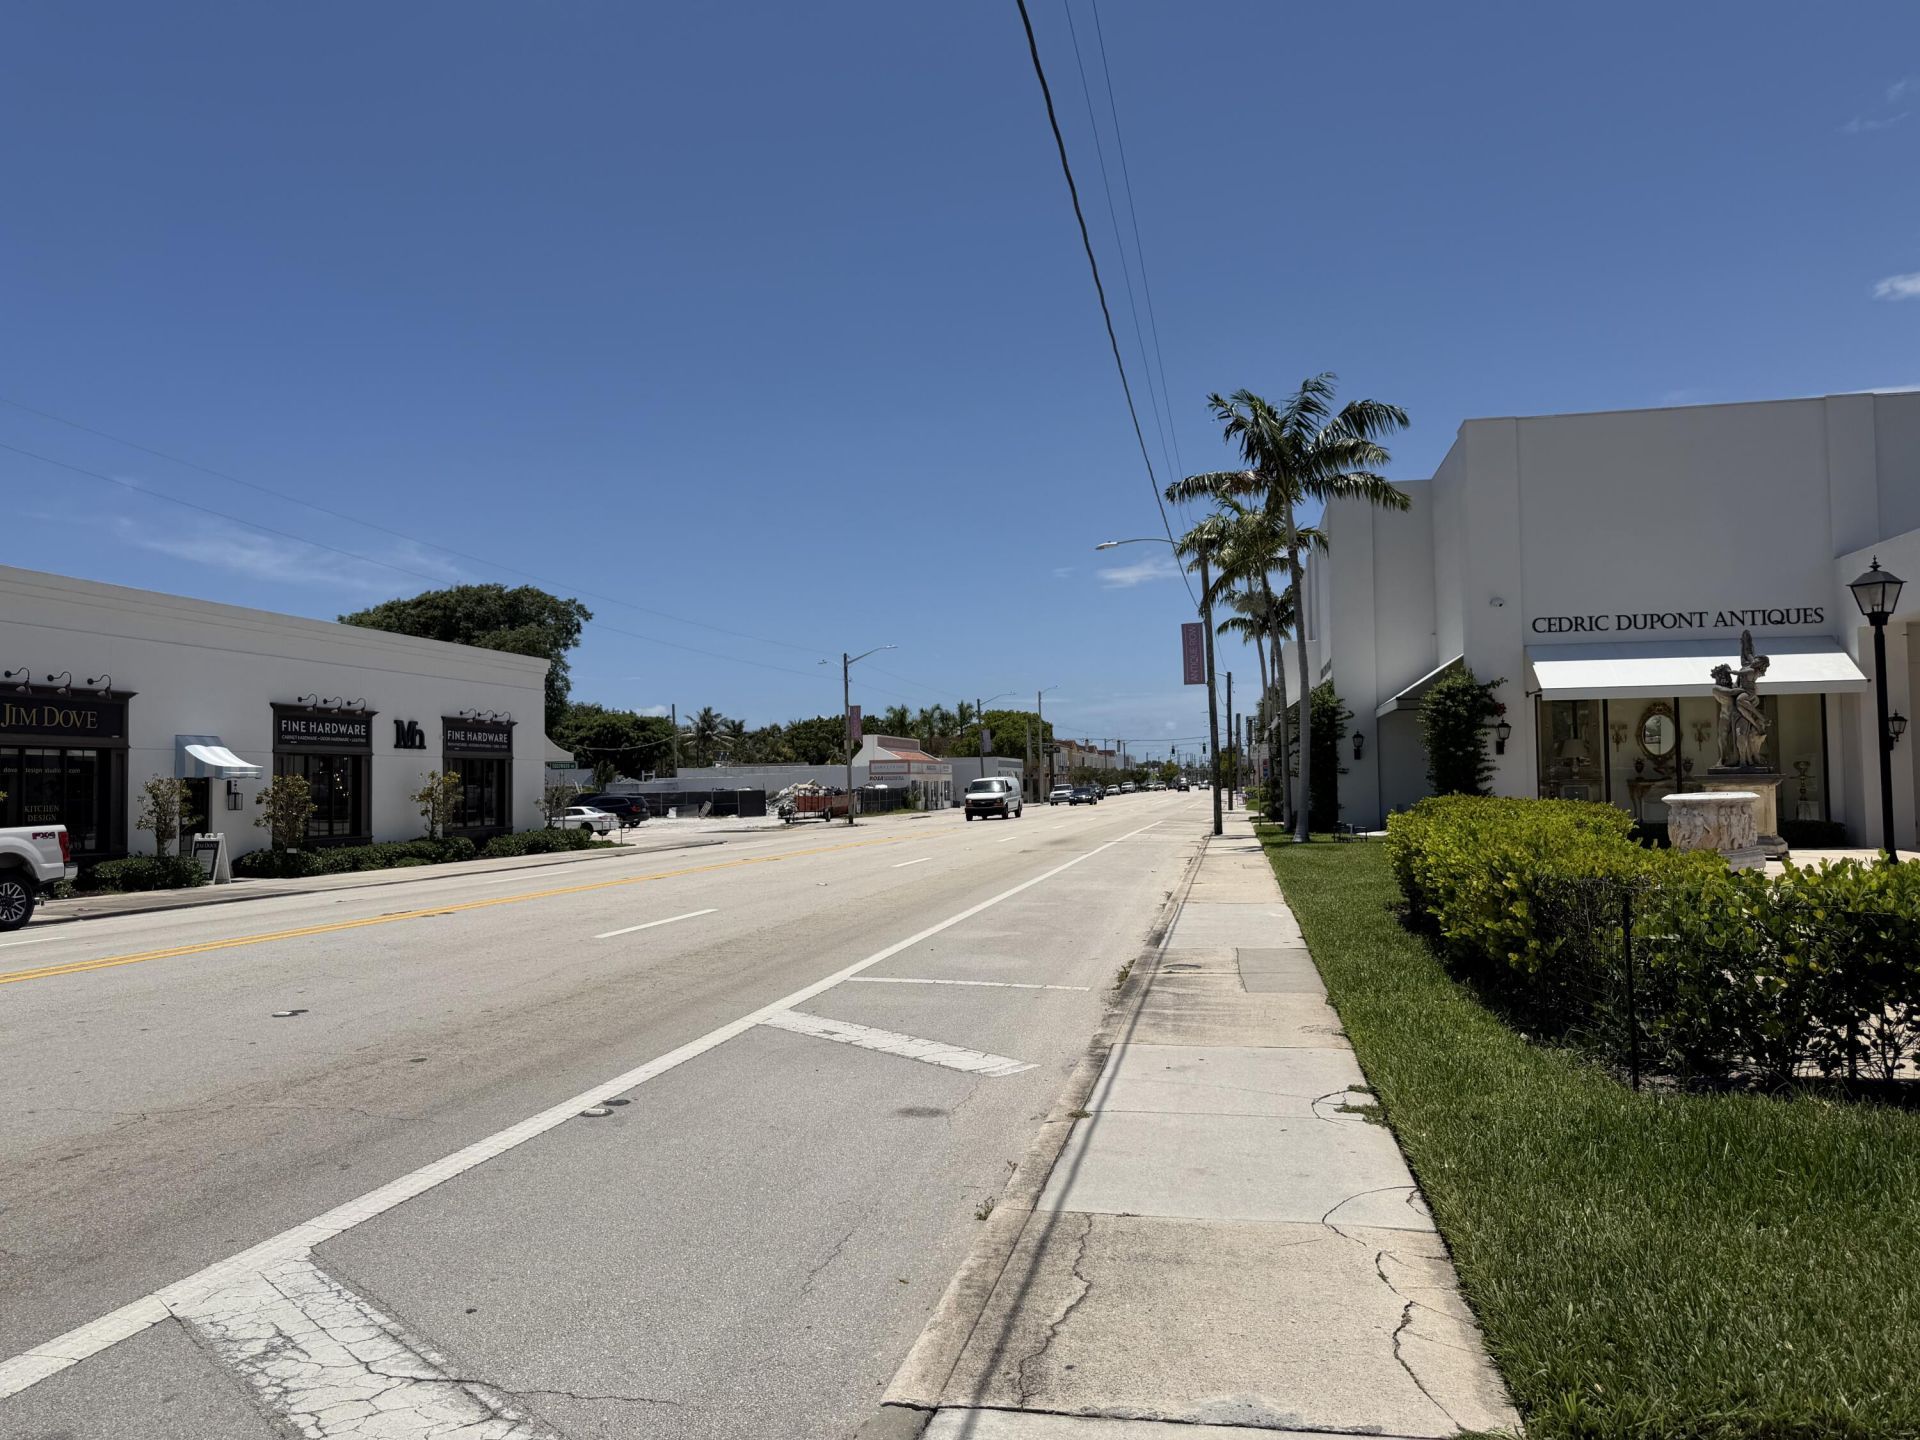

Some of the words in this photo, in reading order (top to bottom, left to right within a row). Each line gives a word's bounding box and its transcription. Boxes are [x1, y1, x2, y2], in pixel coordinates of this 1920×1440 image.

[1532, 614, 1610, 633] CEDRIC
[1615, 611, 1709, 631] DUPONT
[1712, 607, 1825, 628] ANTIQUES
[0, 703, 38, 727] JIM
[42, 706, 98, 729] DOVE
[281, 720, 306, 733] FINE
[309, 721, 367, 735] HARDWARE
[447, 730, 465, 741] FINE
[466, 731, 508, 743] HARDWARE
[24, 804, 60, 813] KITCHEN
[28, 814, 57, 822] DESIGN
